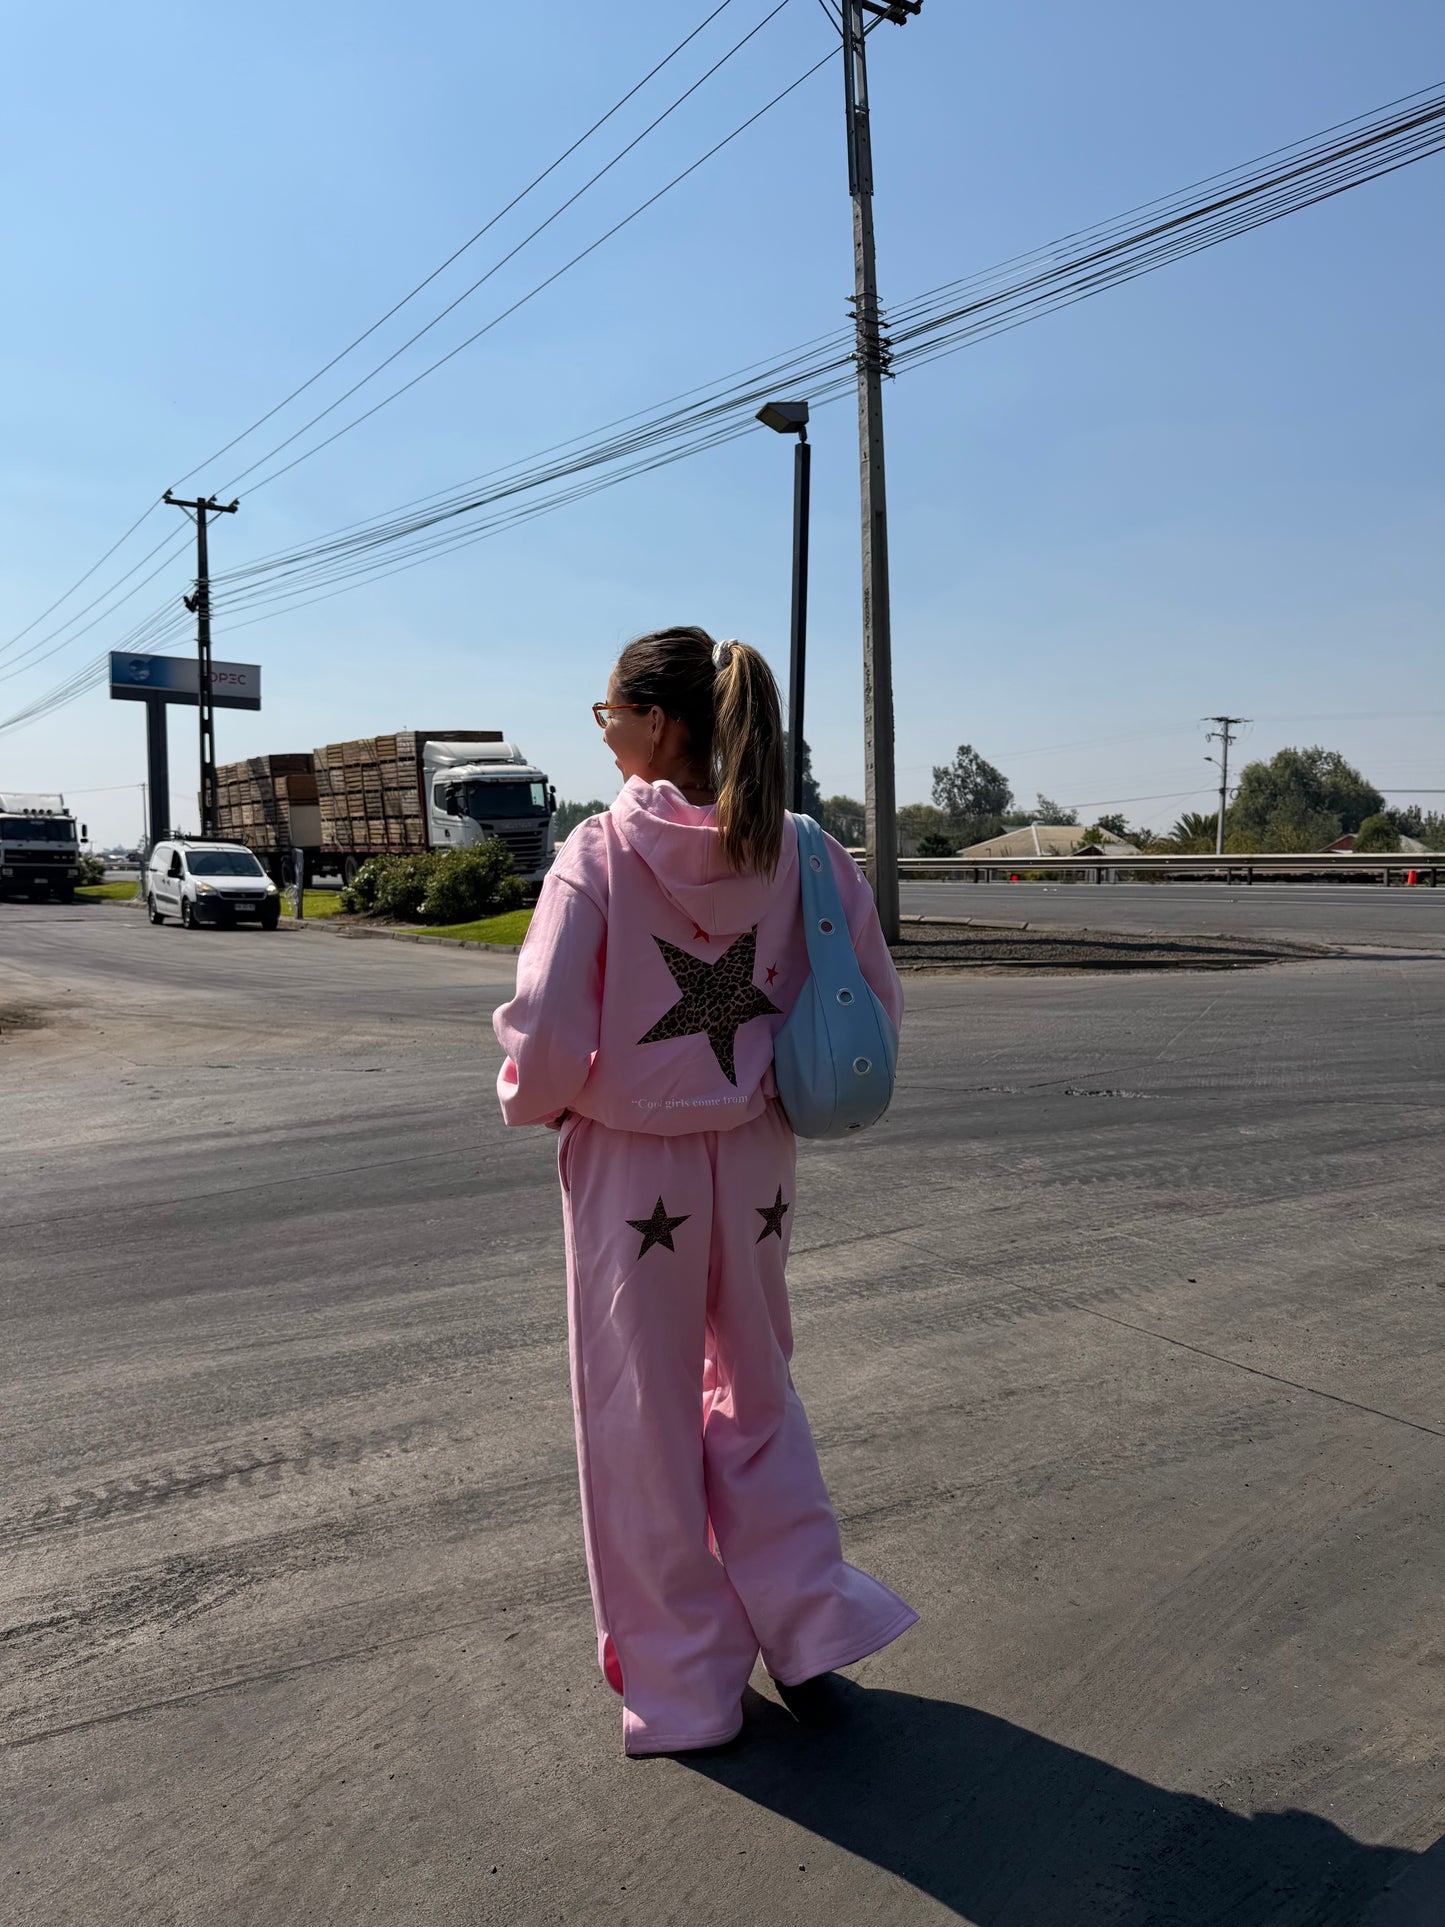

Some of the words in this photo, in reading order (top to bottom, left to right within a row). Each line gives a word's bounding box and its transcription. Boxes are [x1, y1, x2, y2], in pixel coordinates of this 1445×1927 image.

[198, 672, 247, 686] OPEC
[665, 1098, 690, 1111] girls
[692, 1099, 720, 1108] come
[723, 1095, 748, 1105] from
